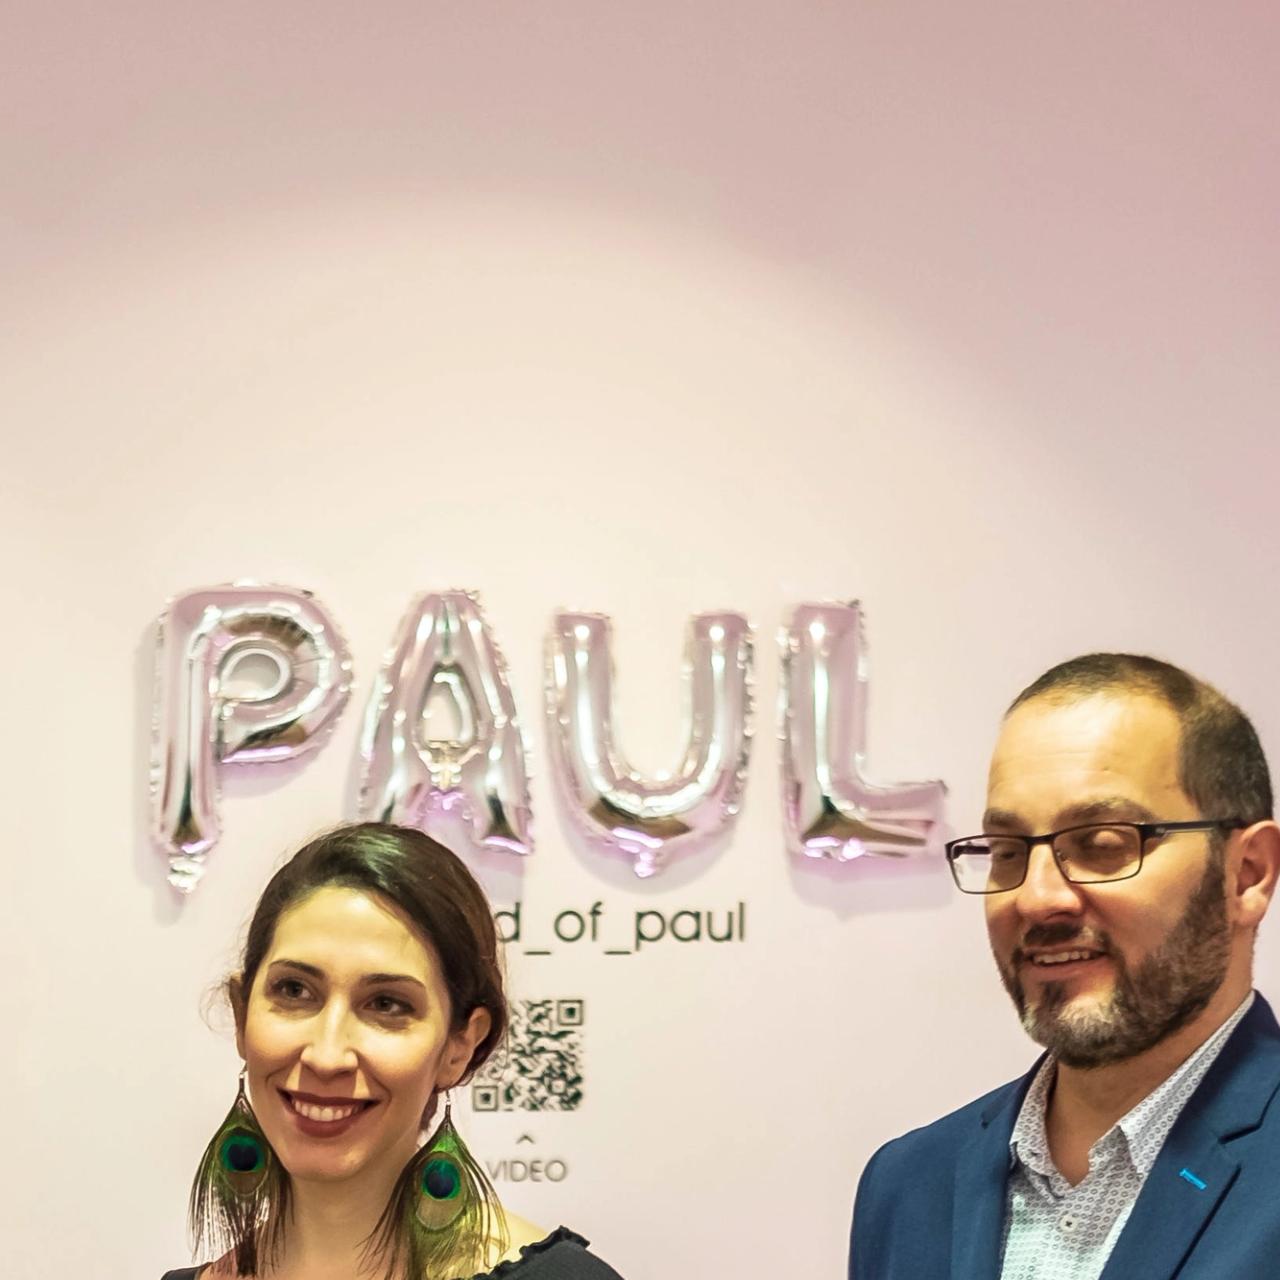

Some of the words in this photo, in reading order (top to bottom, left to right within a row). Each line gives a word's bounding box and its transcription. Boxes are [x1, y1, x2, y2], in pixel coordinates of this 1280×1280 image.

[149, 582, 948, 880] PAUL
[495, 901, 745, 956] d_of_paul
[486, 1159, 568, 1182] VIDEO
